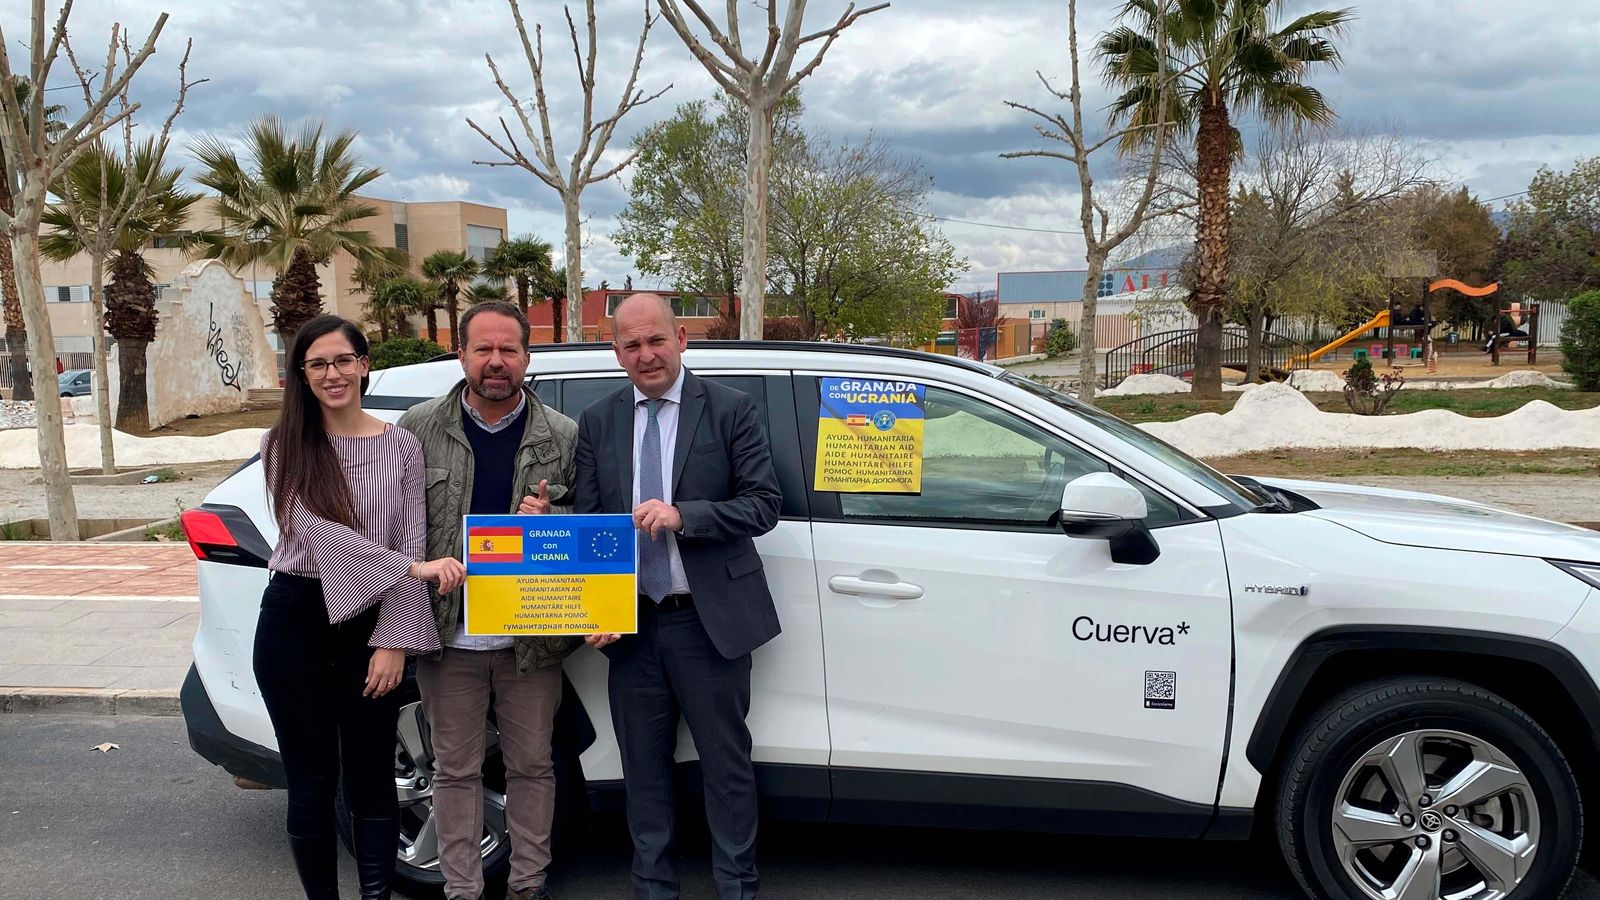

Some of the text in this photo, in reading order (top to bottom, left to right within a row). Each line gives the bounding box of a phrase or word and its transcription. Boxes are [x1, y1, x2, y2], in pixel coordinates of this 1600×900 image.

[840, 381, 917, 392] GRANADA
[846, 393, 917, 404] UCRANIA
[825, 442, 896, 450] HUMANITARIAN
[850, 452, 914, 460] HUMANITAIRE
[824, 460, 885, 468] HUMANITÄRE
[529, 530, 572, 538] GRANADA
[531, 553, 570, 561] UCRANIA
[1244, 584, 1299, 596] HYBRID
[503, 622, 600, 631] гуманитарная помощь
